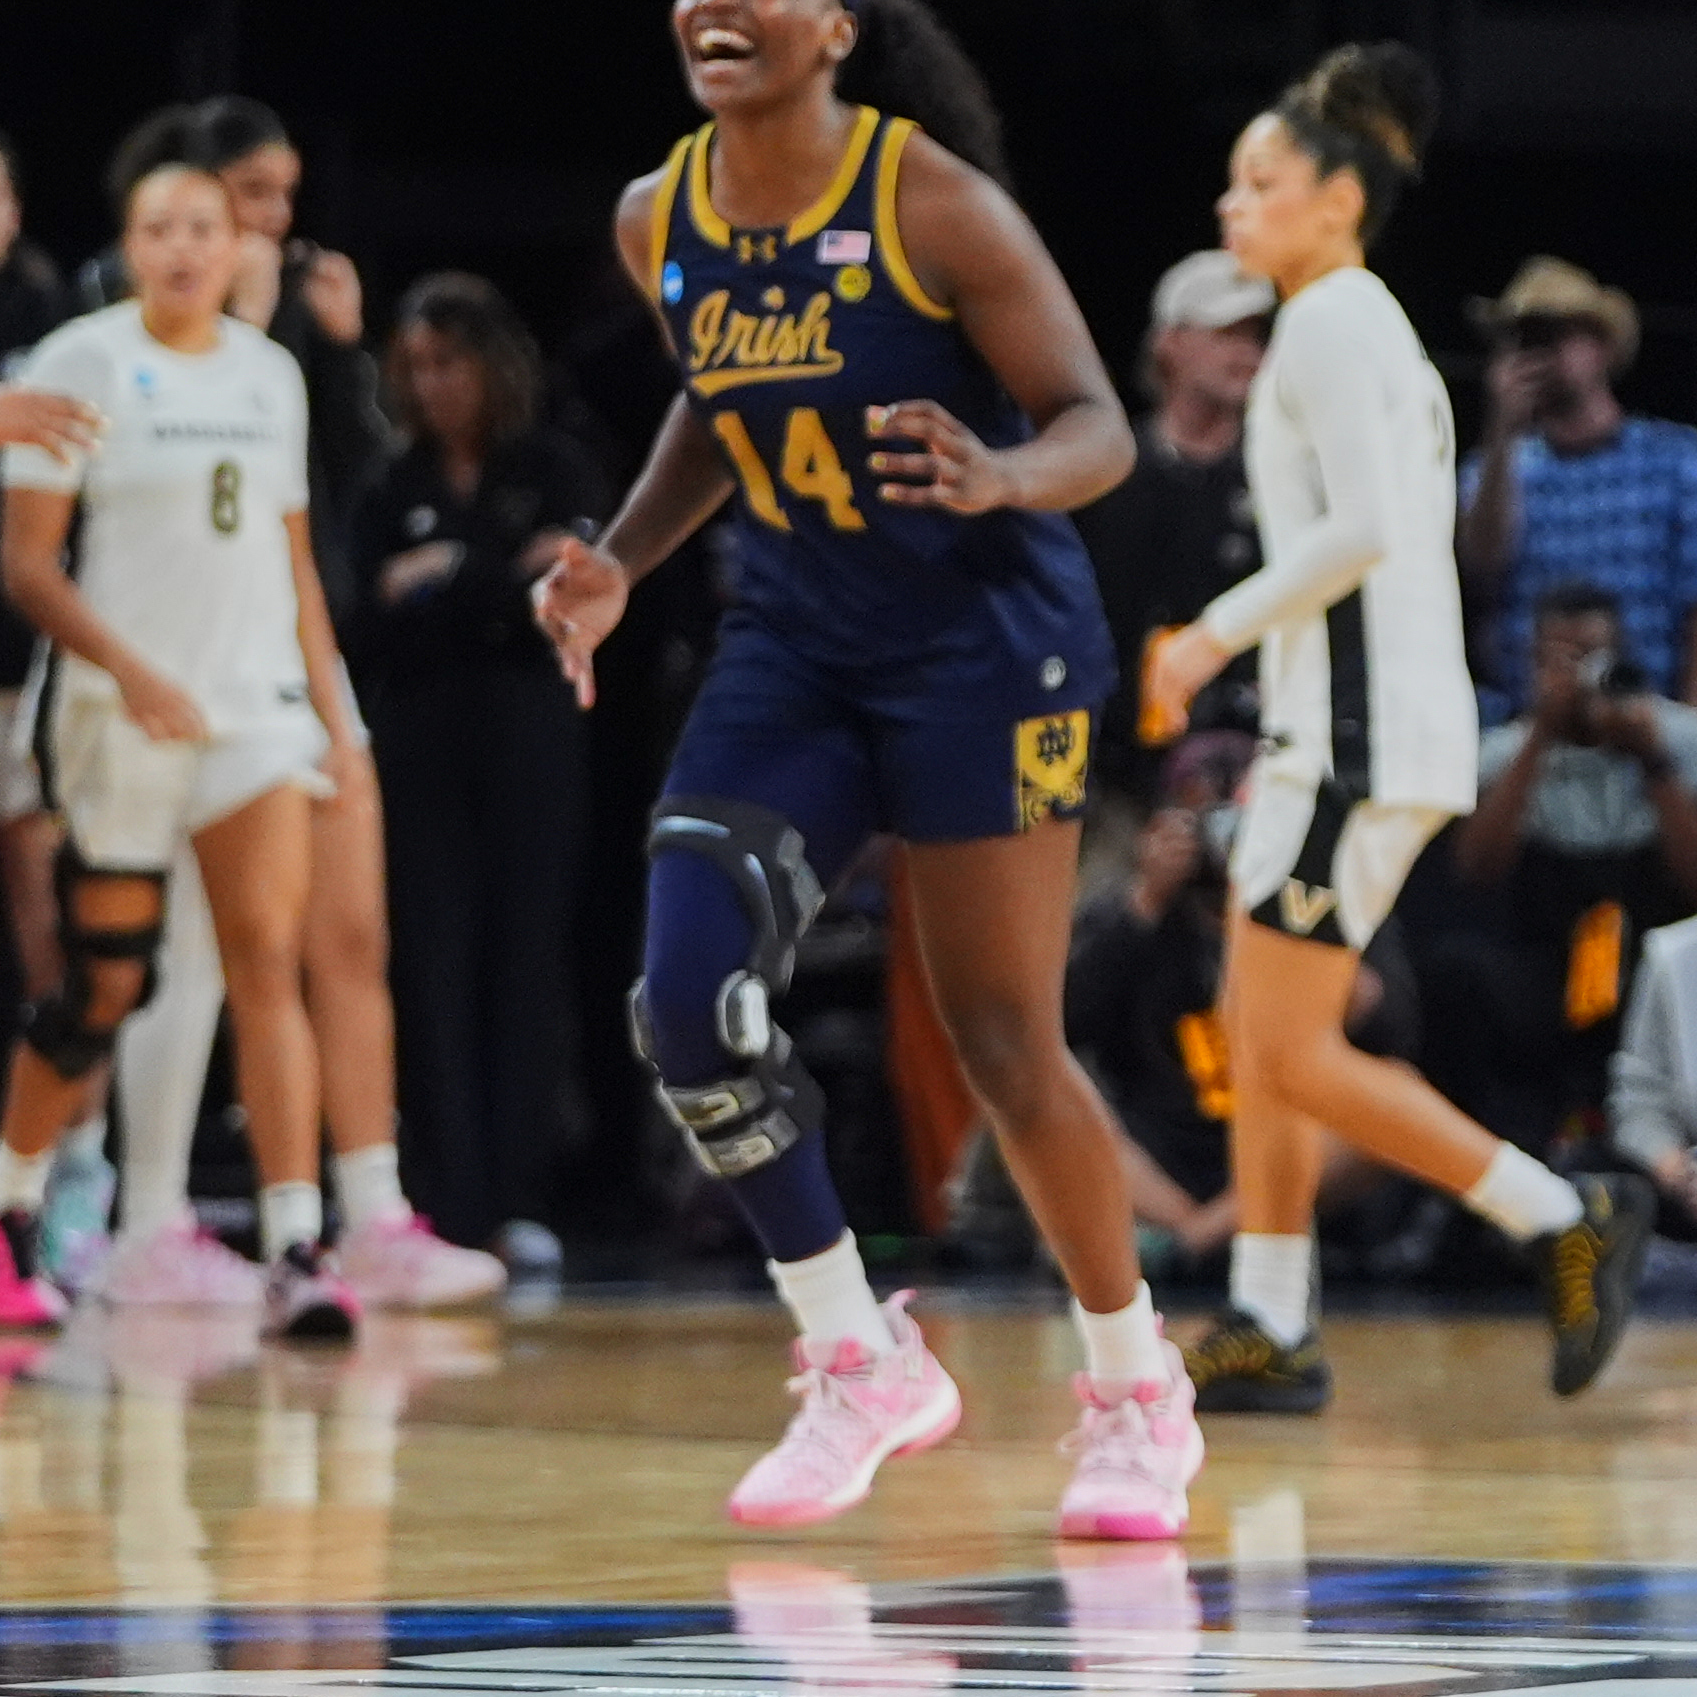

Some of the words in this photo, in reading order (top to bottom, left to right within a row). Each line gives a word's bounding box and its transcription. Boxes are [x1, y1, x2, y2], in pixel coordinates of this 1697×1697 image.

[687, 285, 846, 375] Irish
[211, 462, 241, 536] 8
[711, 406, 869, 534] 14
